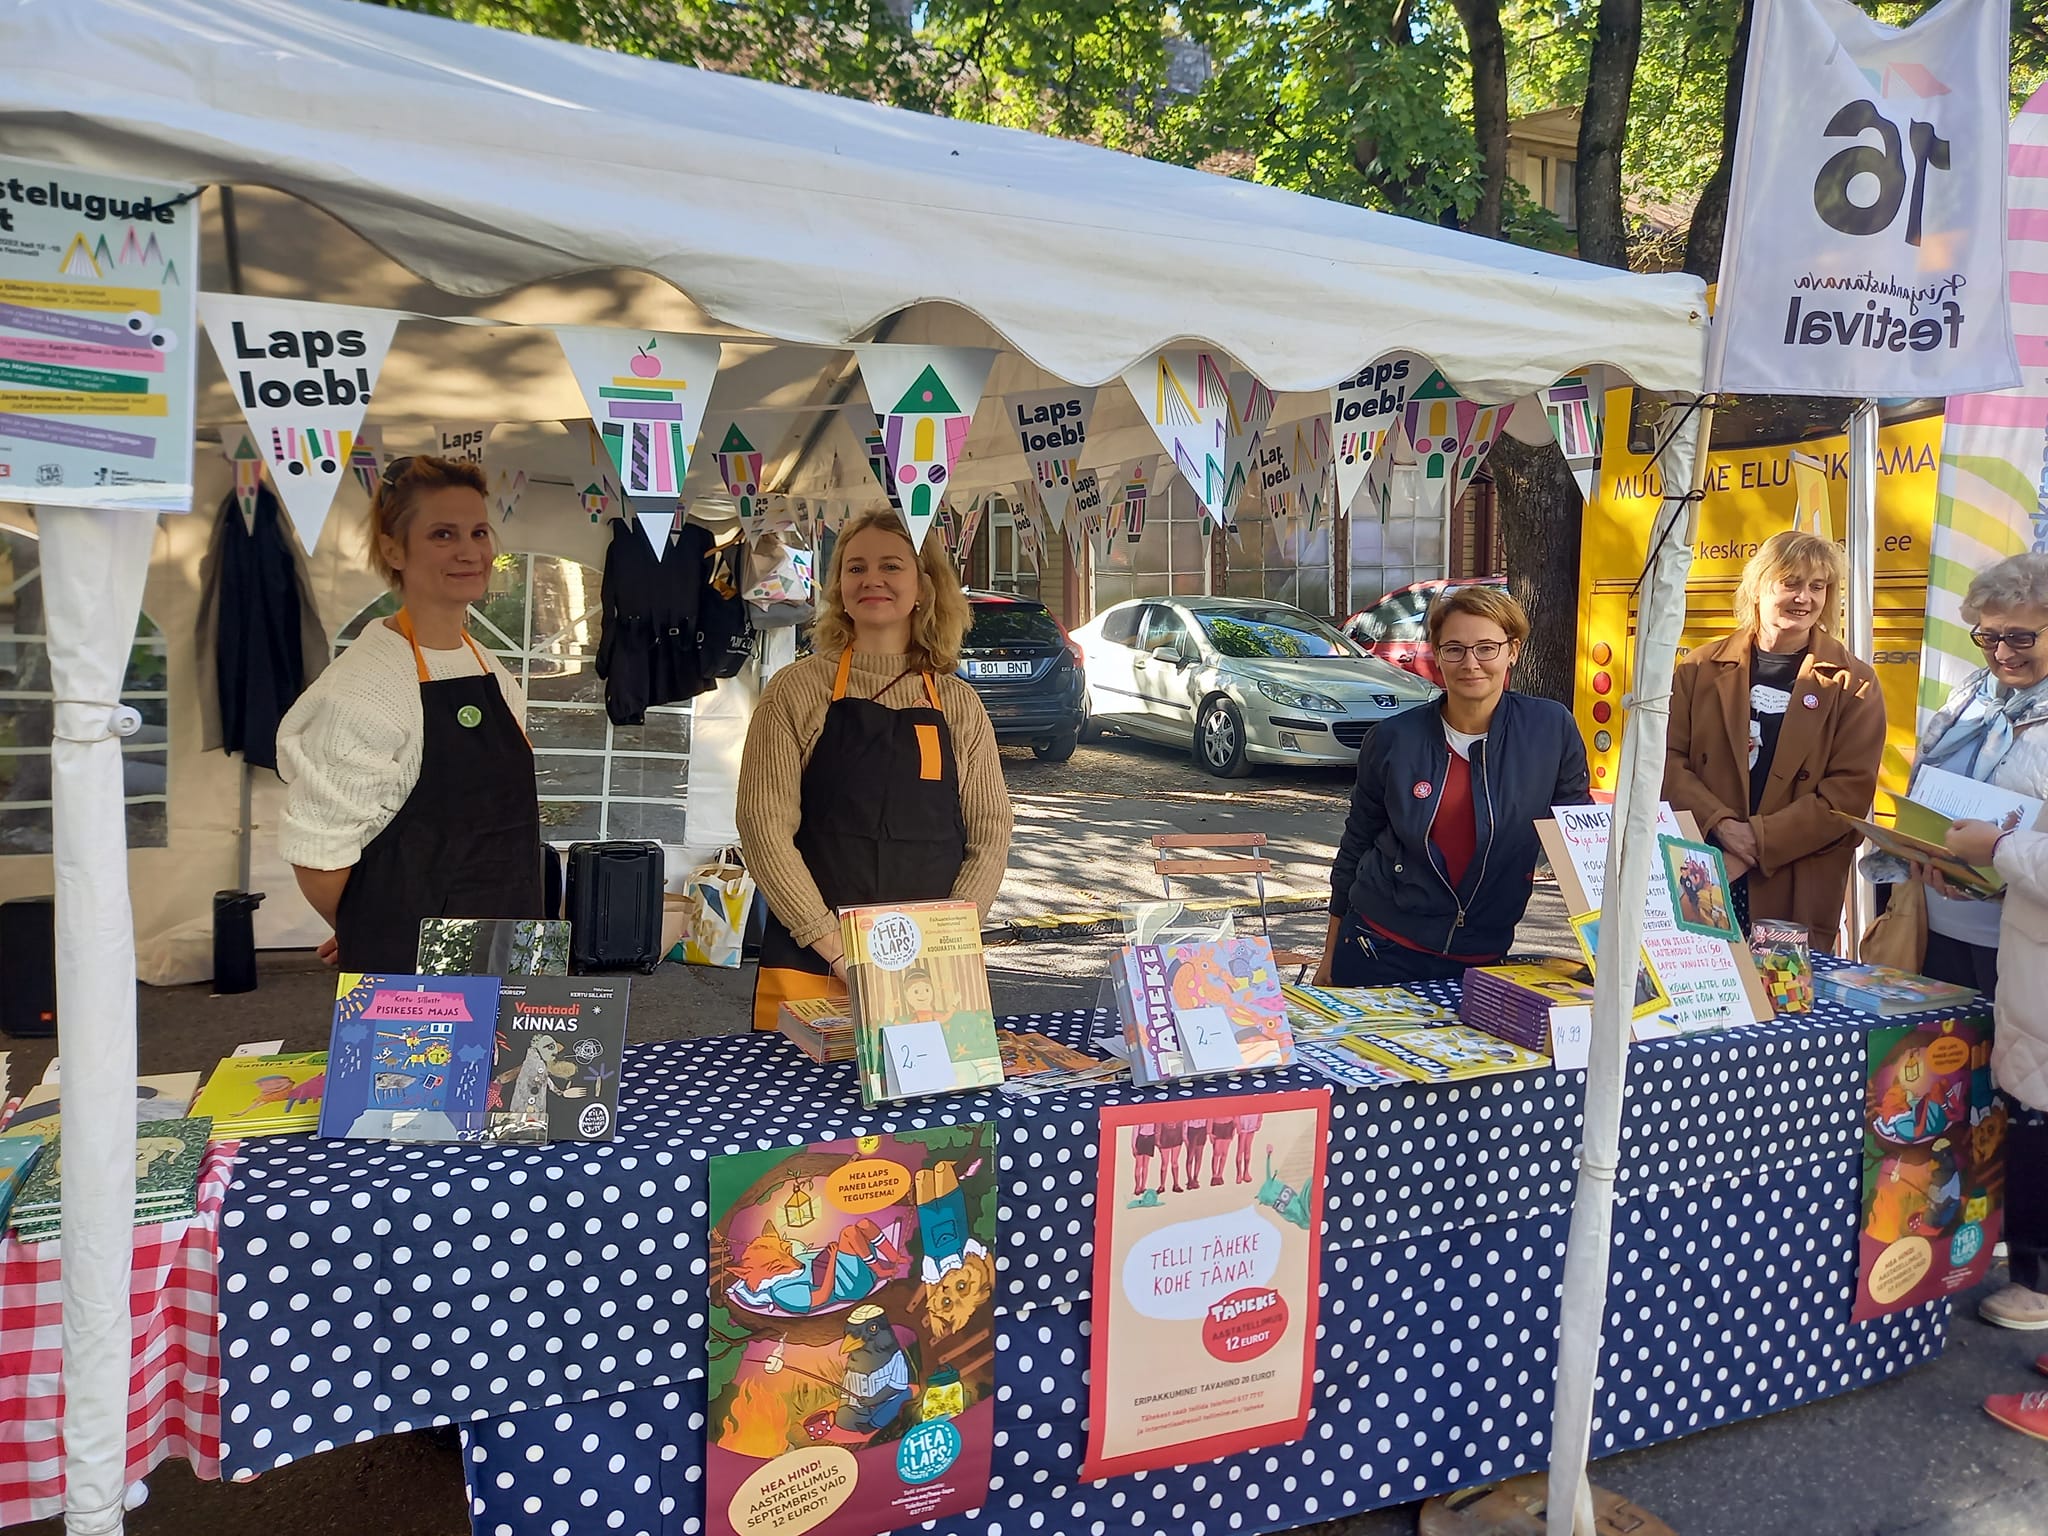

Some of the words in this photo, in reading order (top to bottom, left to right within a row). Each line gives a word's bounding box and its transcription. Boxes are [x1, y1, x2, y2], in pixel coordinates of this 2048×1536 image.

[232, 321, 367, 368] Laps
[239, 368, 372, 408] loeb!
[1017, 400, 1082, 426] Laps
[1334, 385, 1404, 423] loeb!
[442, 430, 483, 450] Laps
[1021, 421, 1085, 453] loeb!
[1072, 476, 1096, 494] Laps
[1741, 463, 1790, 489] ELU
[980, 662, 999, 674] 801
[1007, 662, 1029, 674] BNT
[877, 921, 907, 941] HEA
[880, 937, 910, 956] LAPS
[1710, 945, 1721, 955] 50
[376, 1005, 423, 1015] PISIKESES
[428, 1008, 459, 1016] MAJAS
[515, 1002, 581, 1016] Vanataadi
[1692, 1005, 1731, 1021] VANEMD
[838, 1182, 866, 1193] PANEB
[868, 1178, 900, 1188] LAPSED
[849, 1172, 866, 1181] HEA
[868, 1169, 889, 1178] LAPS
[843, 1189, 895, 1202] TEGUTSEMA!
[1151, 1246, 1192, 1270] TELLI
[1202, 1233, 1260, 1262] TÄHEKE
[1154, 1271, 1192, 1296] KOHE
[1200, 1260, 1254, 1287] TÄNA!
[1211, 1292, 1277, 1323] TÄHEKE
[1226, 1336, 1240, 1351] 12
[1241, 1331, 1270, 1347] EUROT
[1134, 1386, 1198, 1407] ERIPAKKUMINE!
[1200, 1377, 1240, 1392] TAVAHIND
[1250, 1370, 1276, 1382] EUROT
[909, 1429, 945, 1455] HEA
[910, 1445, 947, 1470] LAPS
[750, 1465, 840, 1514] AASTATELLIMUS
[760, 1478, 786, 1496] HEA
[787, 1460, 822, 1483] HIND!
[747, 1488, 819, 1528] SEPTEMBRIS
[820, 1475, 847, 1493] VAID
[772, 1516, 785, 1528] 12
[787, 1496, 828, 1521] EUROT!
